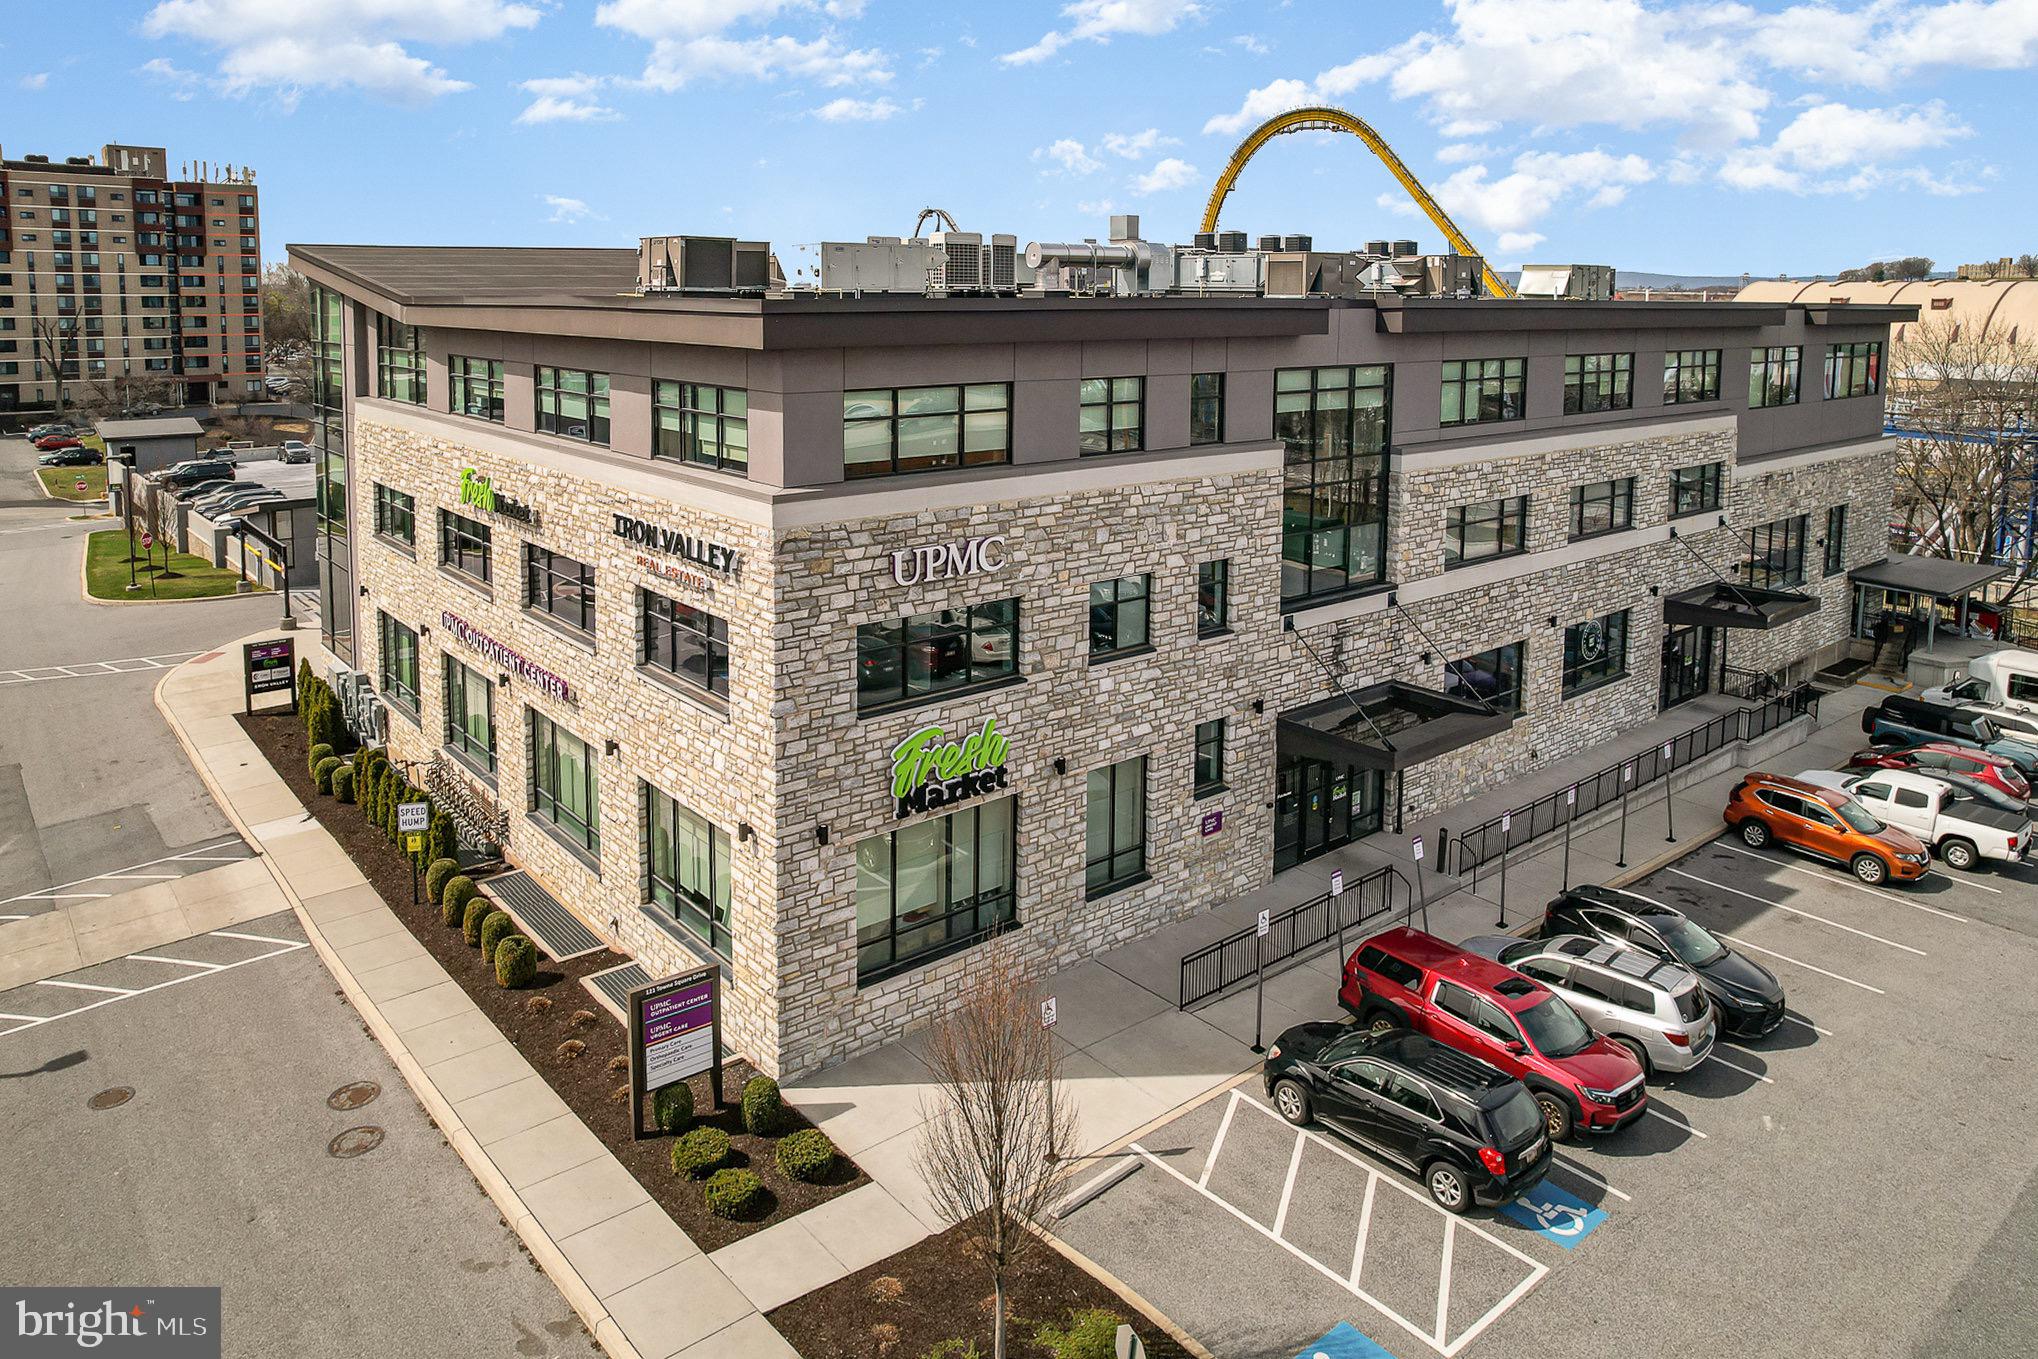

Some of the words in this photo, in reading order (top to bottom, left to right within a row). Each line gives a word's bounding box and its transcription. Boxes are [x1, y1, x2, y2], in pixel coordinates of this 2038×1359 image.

[613, 513, 658, 548] IRON
[662, 528, 735, 573] VALLEY
[636, 554, 661, 573] REAL
[664, 566, 706, 590] ESTATE
[891, 536, 1006, 586] UPMC
[442, 611, 469, 641] UPMC
[465, 628, 525, 675] OUTPATIENT
[523, 661, 569, 701] CENTER
[890, 716, 1011, 799] Fresh
[893, 764, 1009, 820] Market
[400, 807, 426, 817] SPEED
[402, 818, 425, 827] HUMP
[674, 976, 692, 986] Square
[650, 999, 671, 1011] UPMC
[650, 1001, 686, 1017] OUTPATIENT
[686, 993, 708, 1005] CENTER
[650, 1022, 671, 1034] UPMC
[650, 1029, 672, 1040] URGENT
[673, 1022, 688, 1032] CARE
